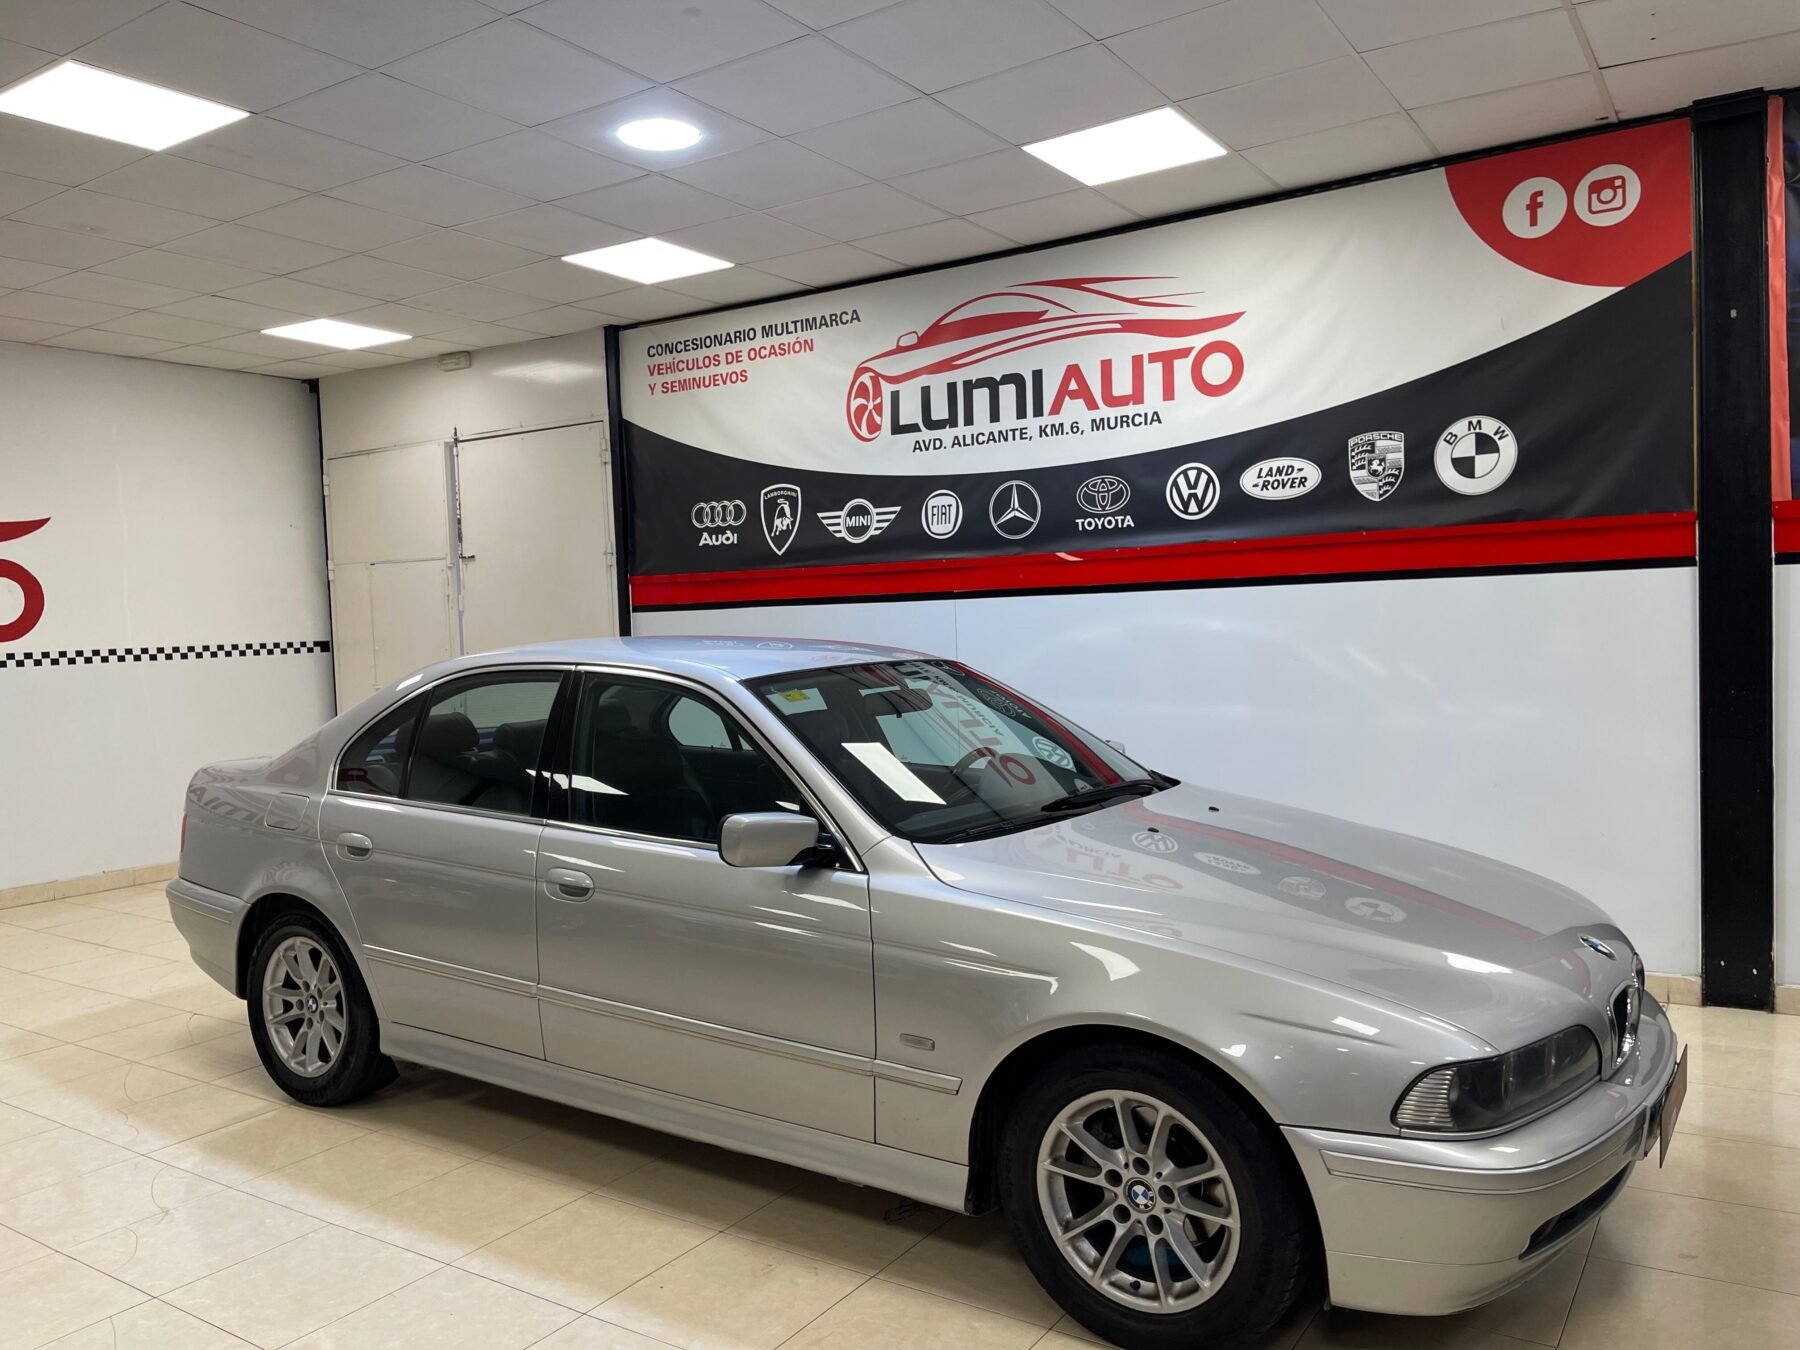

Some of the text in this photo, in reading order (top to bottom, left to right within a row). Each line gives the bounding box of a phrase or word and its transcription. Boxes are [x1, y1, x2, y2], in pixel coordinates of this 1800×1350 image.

[647, 309, 861, 358] CONCESIONARIO MULTIMARCA
[647, 337, 814, 377] VEHÍCULOS DE OCASIÓN
[648, 369, 748, 396] Y SEMINUEVOS
[912, 411, 1162, 453] AVD. ALICANTE, KM.6, MURCIA
[1350, 433, 1403, 447] PORSCHE
[1443, 419, 1509, 446] BMW
[1256, 464, 1295, 479] LAND
[1260, 476, 1308, 492] ROVER
[846, 515, 871, 528] MINI
[931, 503, 953, 526] FIAT
[1075, 515, 1135, 531] TOYOTA
[698, 530, 738, 546] Audi
